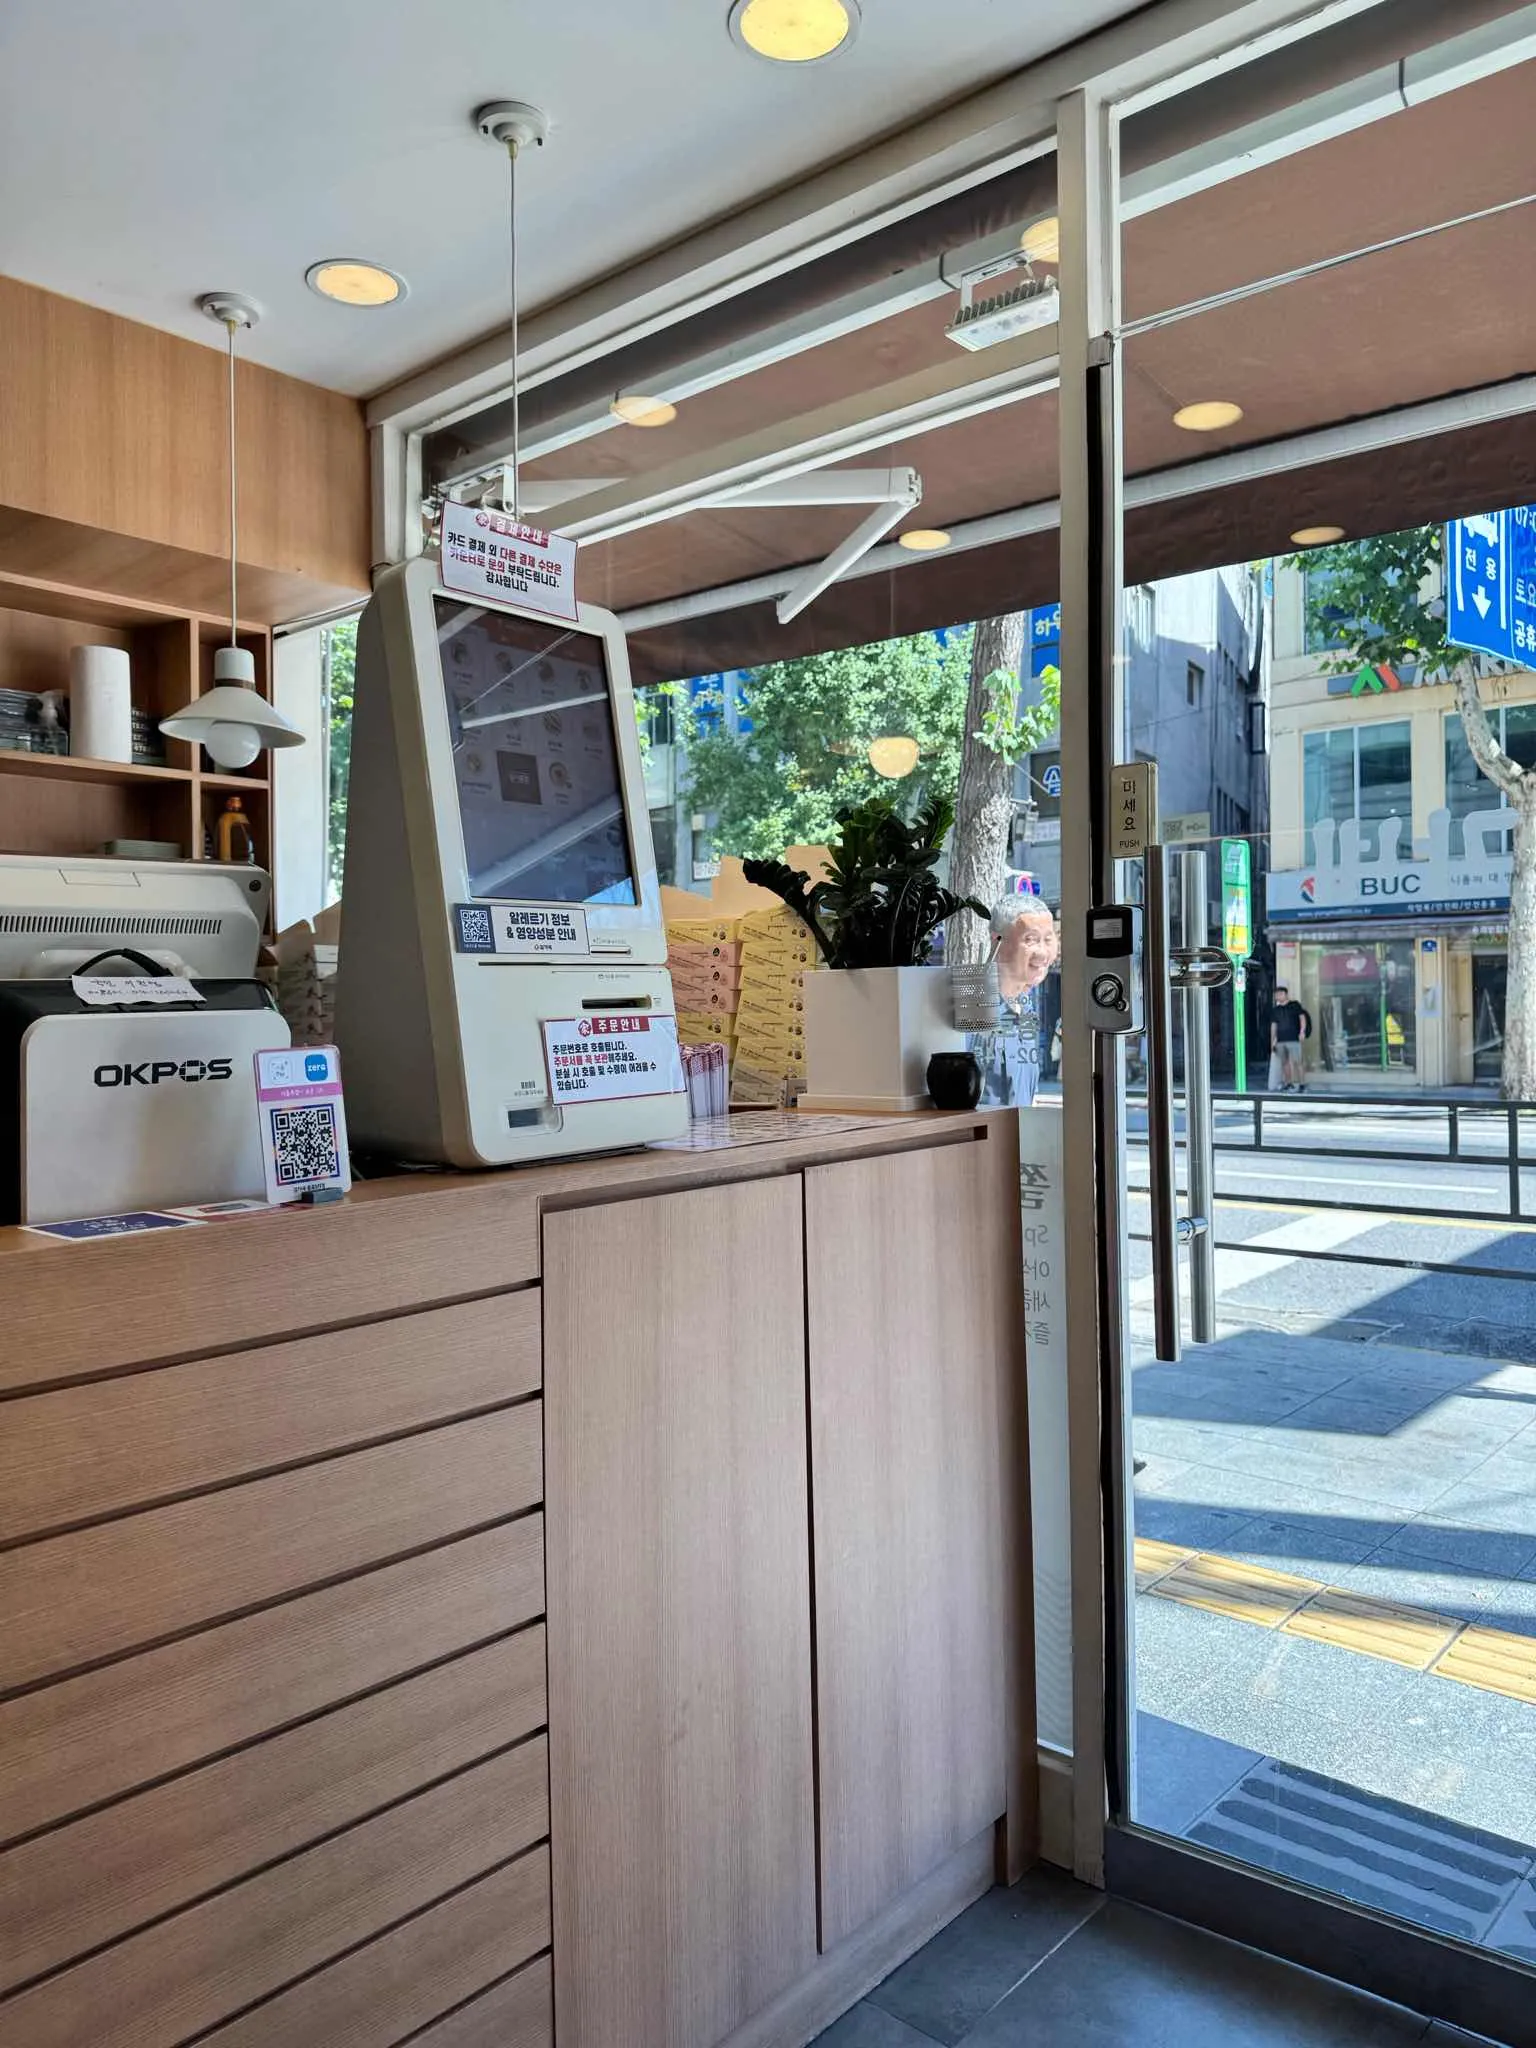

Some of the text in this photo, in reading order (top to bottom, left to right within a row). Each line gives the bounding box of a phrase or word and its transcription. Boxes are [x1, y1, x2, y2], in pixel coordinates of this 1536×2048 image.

[447, 531, 562, 576] 카드 결제 외 다른 결제 수단은
[488, 558, 506, 573] 문의
[508, 563, 560, 588] 부탁드립니다.
[485, 571, 529, 592] 감사합니다
[1122, 780, 1137, 831] 미세요
[1119, 839, 1140, 848] PUSH
[1360, 874, 1421, 895] BUC
[509, 912, 570, 926] 알레르기 정보
[507, 928, 514, 938] &
[516, 927, 556, 941] 영양성분
[558, 927, 576, 941] 안내
[598, 1017, 641, 1033] 주문안내
[552, 1041, 627, 1055] 주문번호로 호출됩니다.
[307, 1064, 326, 1072] zero
[554, 1055, 583, 1067] 주문서를
[585, 1055, 593, 1065] 꼭
[93, 1057, 233, 1088] OKPOS
[555, 1062, 657, 1079] 분실 시 호출 및 수령이 어려울 수
[557, 1079, 589, 1091] 있습니다.
